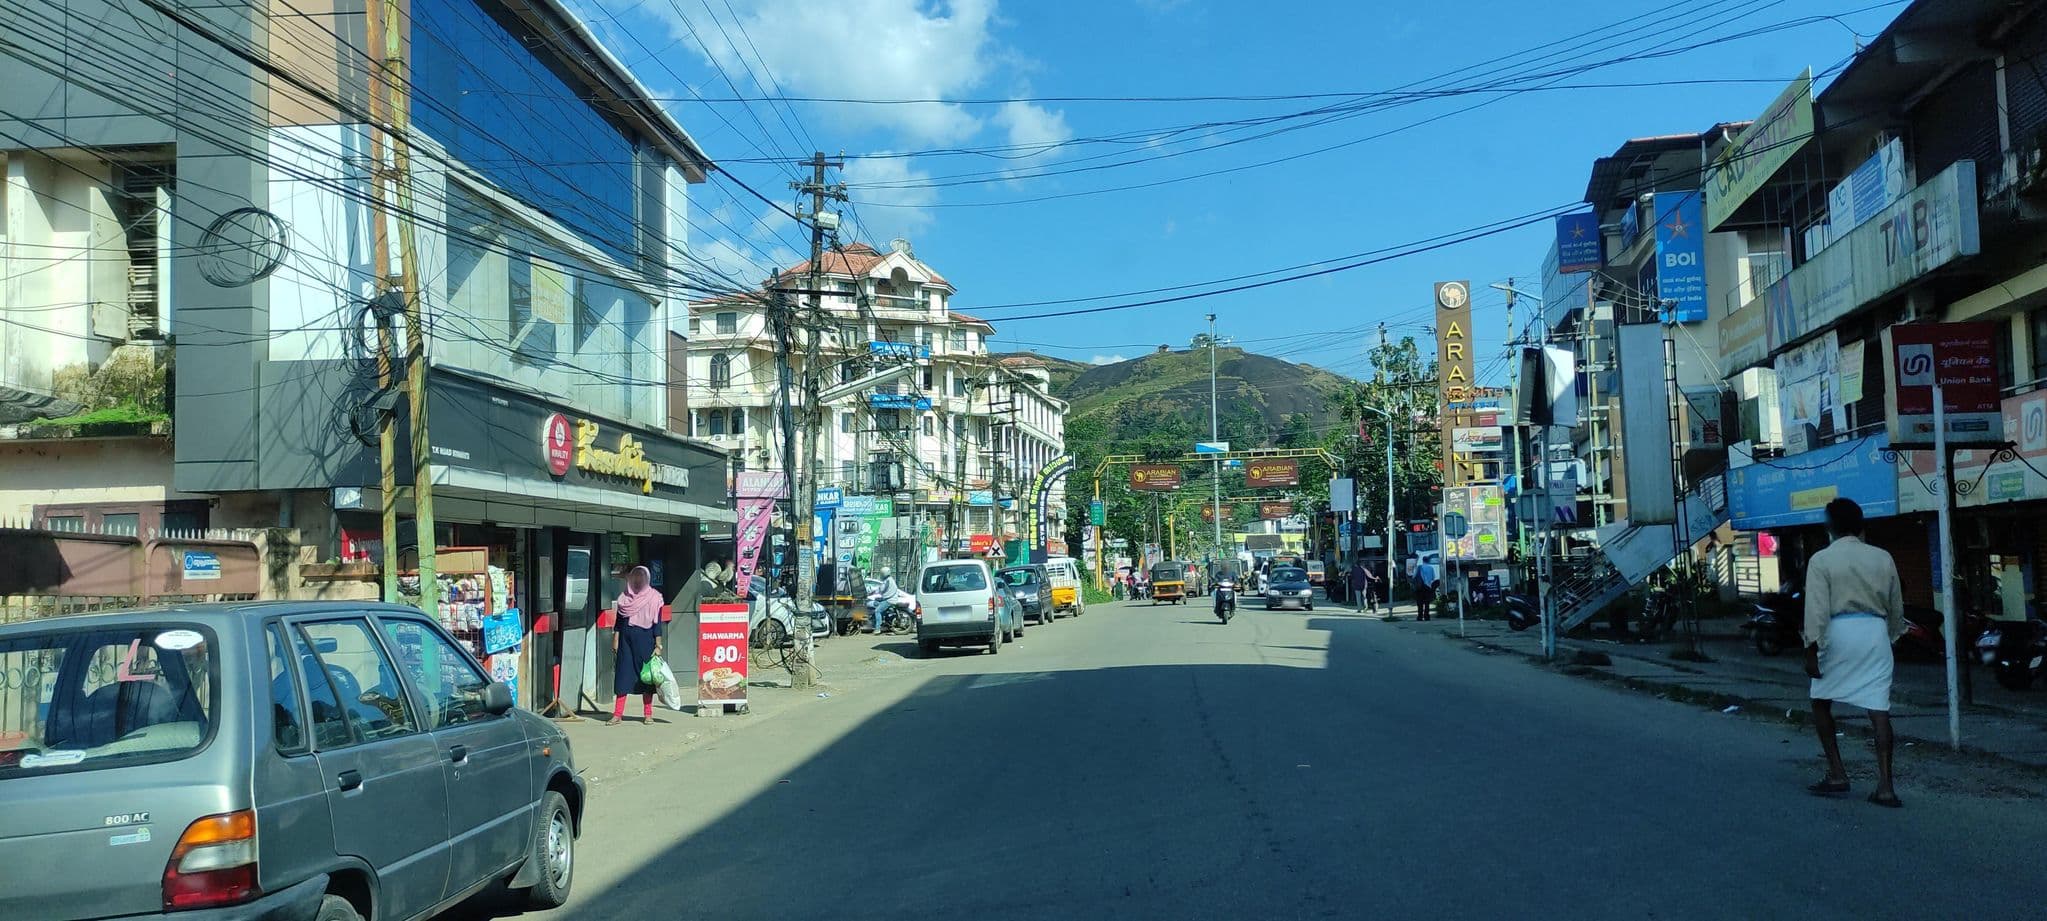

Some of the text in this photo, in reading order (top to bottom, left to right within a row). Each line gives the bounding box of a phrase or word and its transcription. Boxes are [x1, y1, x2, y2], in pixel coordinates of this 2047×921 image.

[1665, 251, 1696, 267] BOI
[1940, 376, 1992, 385] Union Bank
[702, 632, 745, 640] SHAWARMA
[105, 812, 149, 824] 800 AC
